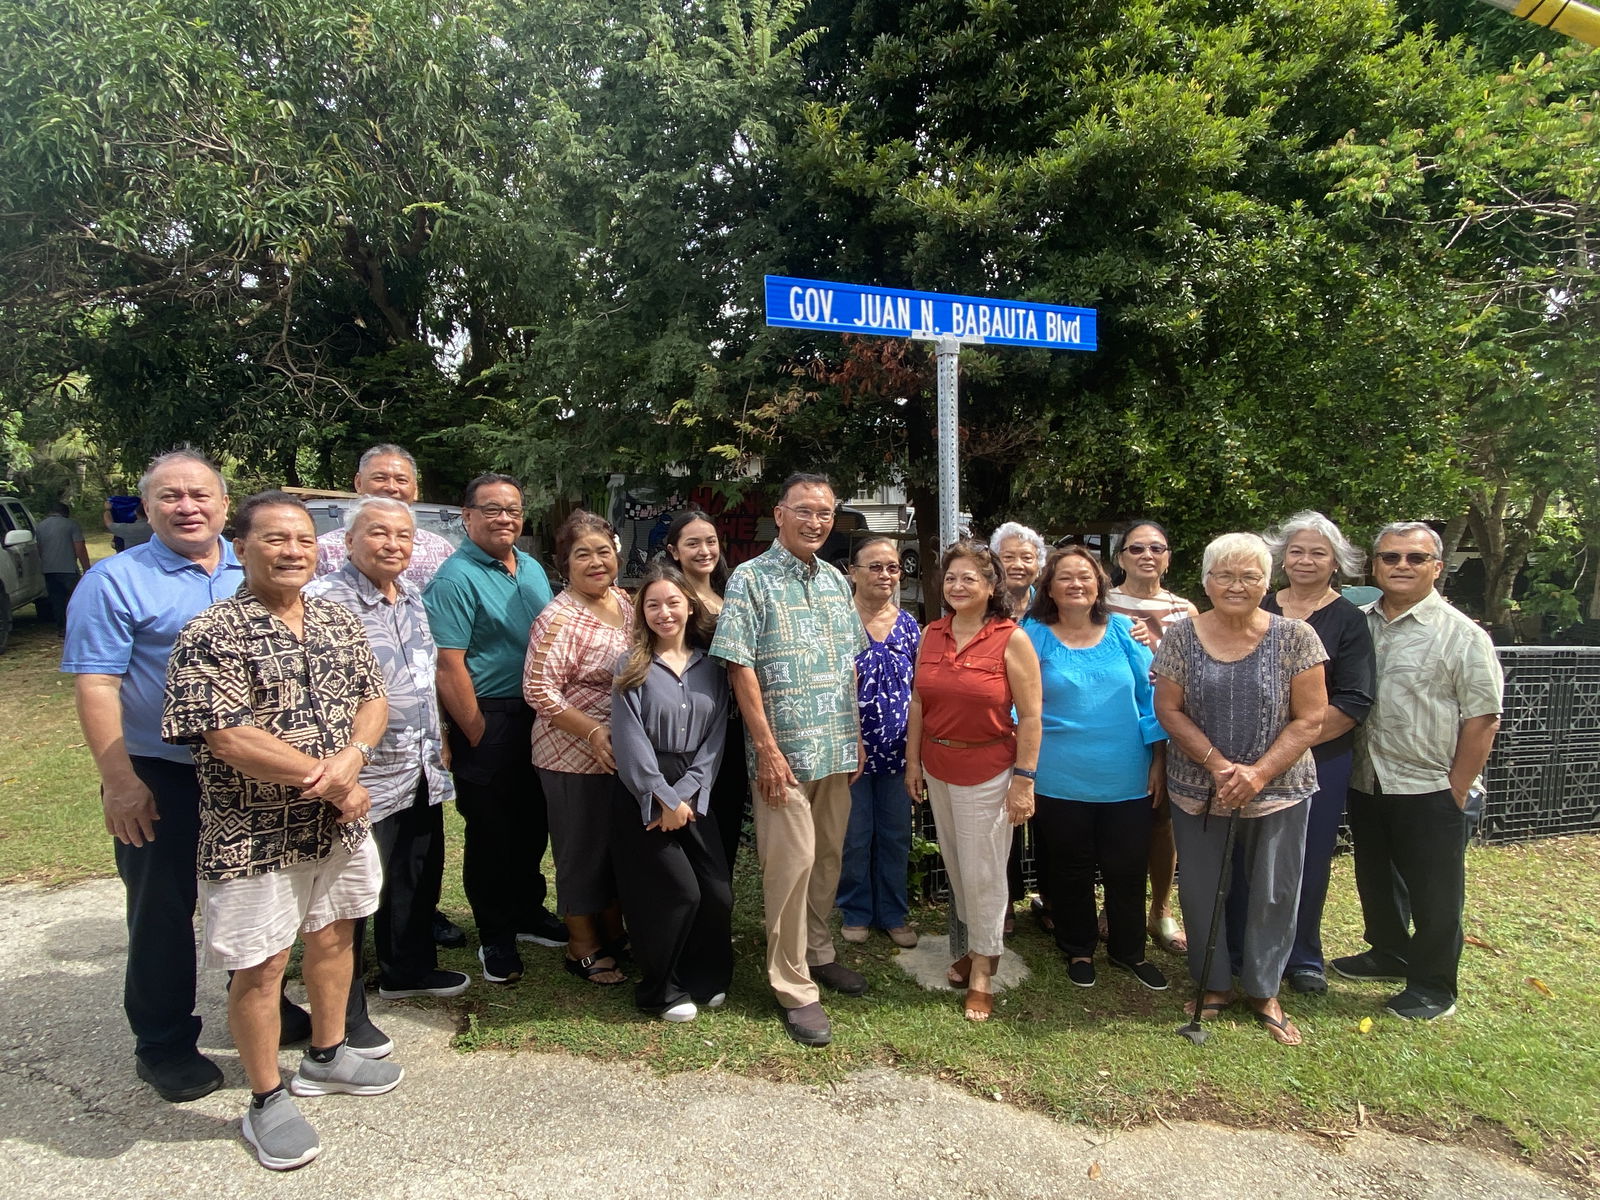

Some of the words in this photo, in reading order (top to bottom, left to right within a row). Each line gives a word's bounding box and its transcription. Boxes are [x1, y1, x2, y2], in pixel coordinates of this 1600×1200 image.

[790, 286, 838, 324] GOV.
[853, 293, 910, 330] JUAN
[921, 300, 940, 333] N.
[952, 303, 1039, 341] BABAUTA
[1046, 312, 1080, 344] Blvd
